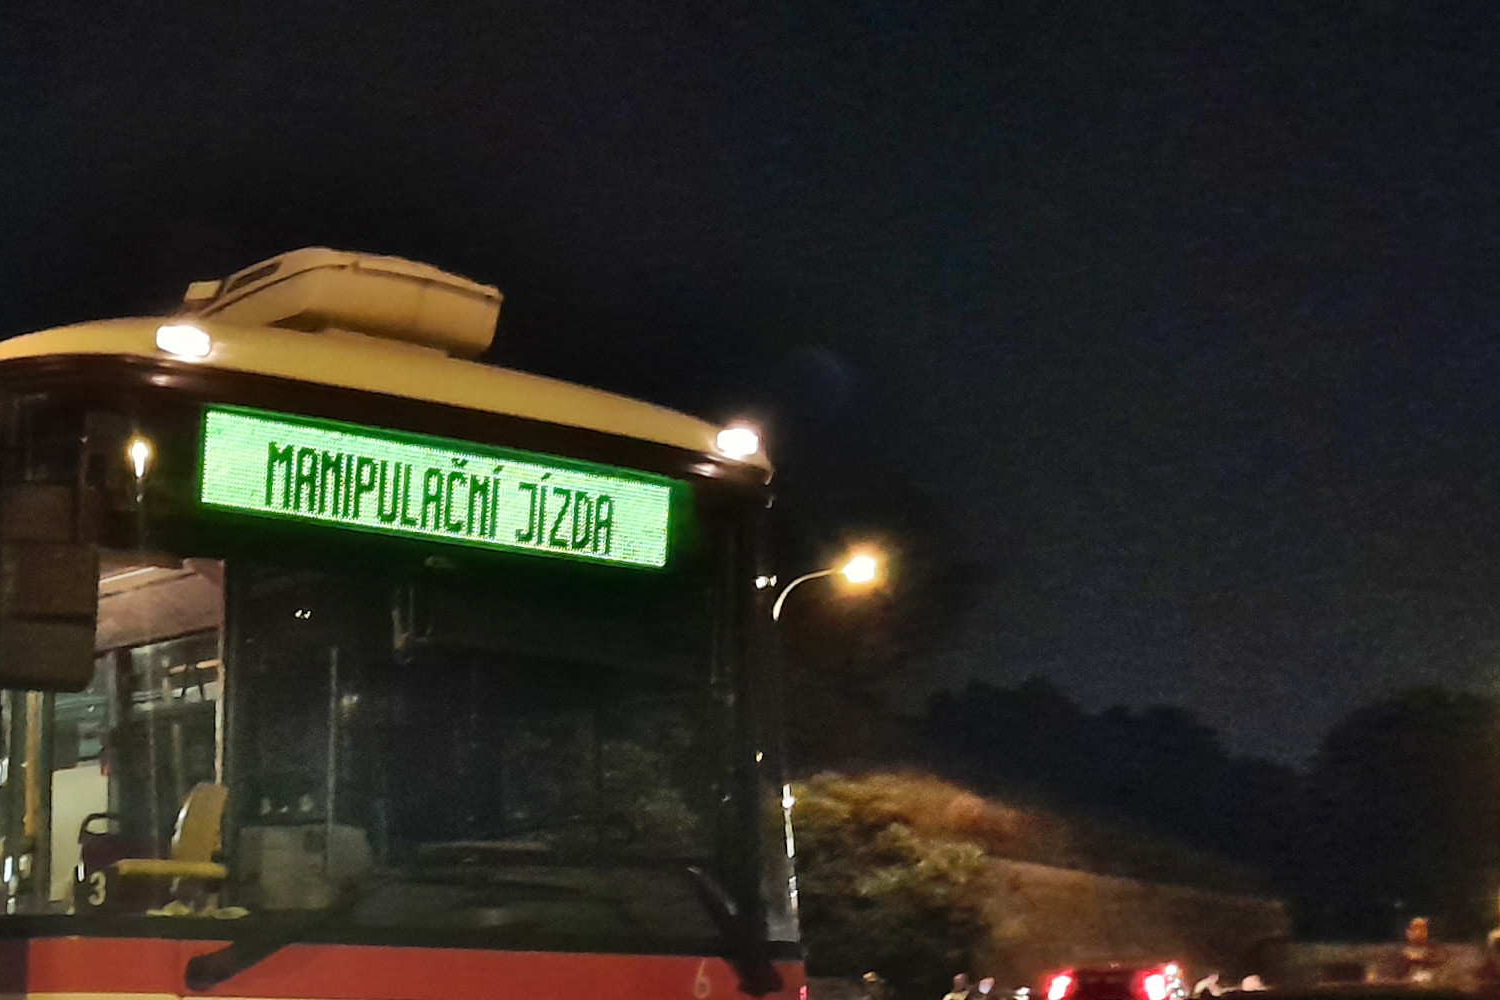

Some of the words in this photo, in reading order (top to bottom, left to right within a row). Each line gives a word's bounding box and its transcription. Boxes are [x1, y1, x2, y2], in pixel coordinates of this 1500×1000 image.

[265, 440, 502, 539] MANIPULAČNÍ
[514, 472, 616, 556] JÍZDA
[88, 869, 106, 906] 3
